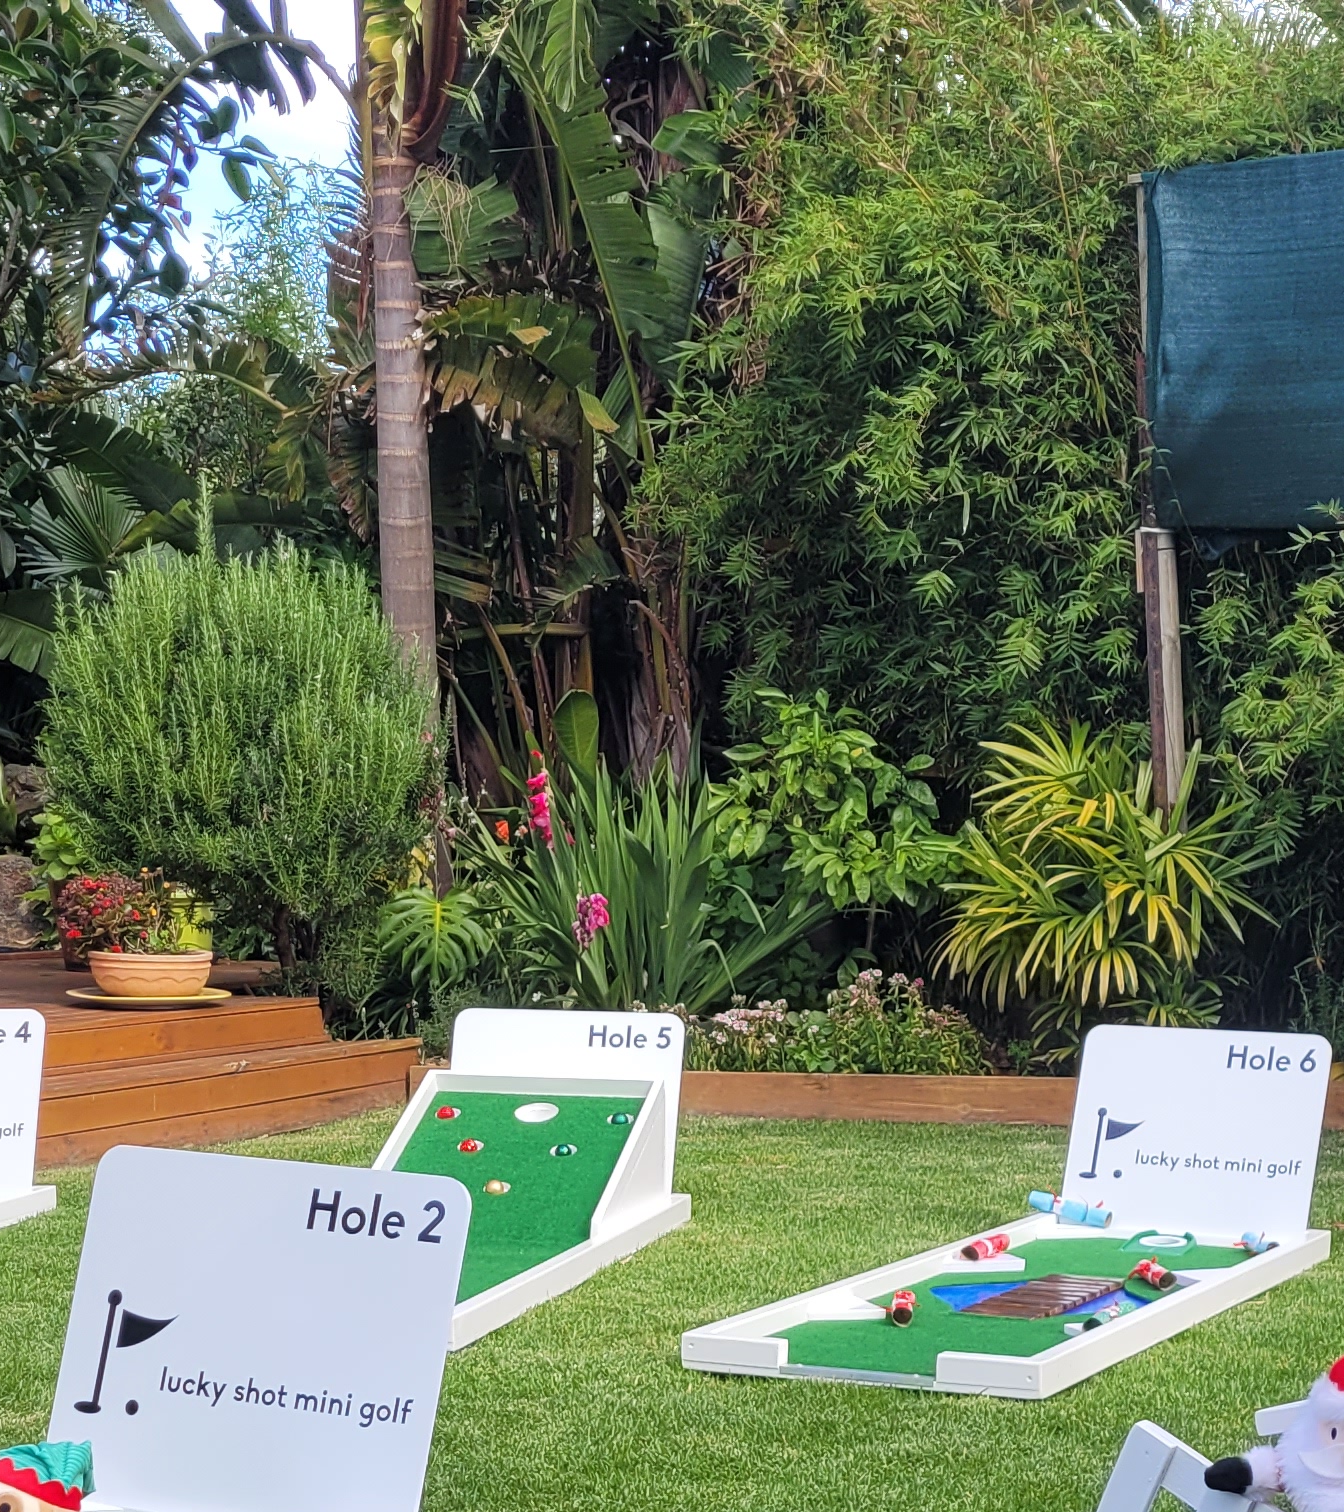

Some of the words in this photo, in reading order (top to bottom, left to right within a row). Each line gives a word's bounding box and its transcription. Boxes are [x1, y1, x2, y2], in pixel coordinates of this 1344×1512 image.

[15, 1022, 31, 1043] 4
[589, 1025, 647, 1048] Hole
[657, 1027, 671, 1049] 5
[1227, 1045, 1290, 1071] Hole
[1300, 1049, 1316, 1072] 6
[1136, 1150, 1179, 1171] lucky
[1184, 1153, 1219, 1169] shot
[1225, 1158, 1262, 1172] mini
[1267, 1160, 1301, 1178] golf
[307, 1189, 405, 1239] Hole
[418, 1200, 445, 1243] 2
[160, 1367, 227, 1406] lucky
[234, 1378, 287, 1407] shot
[294, 1390, 352, 1416] mini
[359, 1398, 413, 1427] golf
